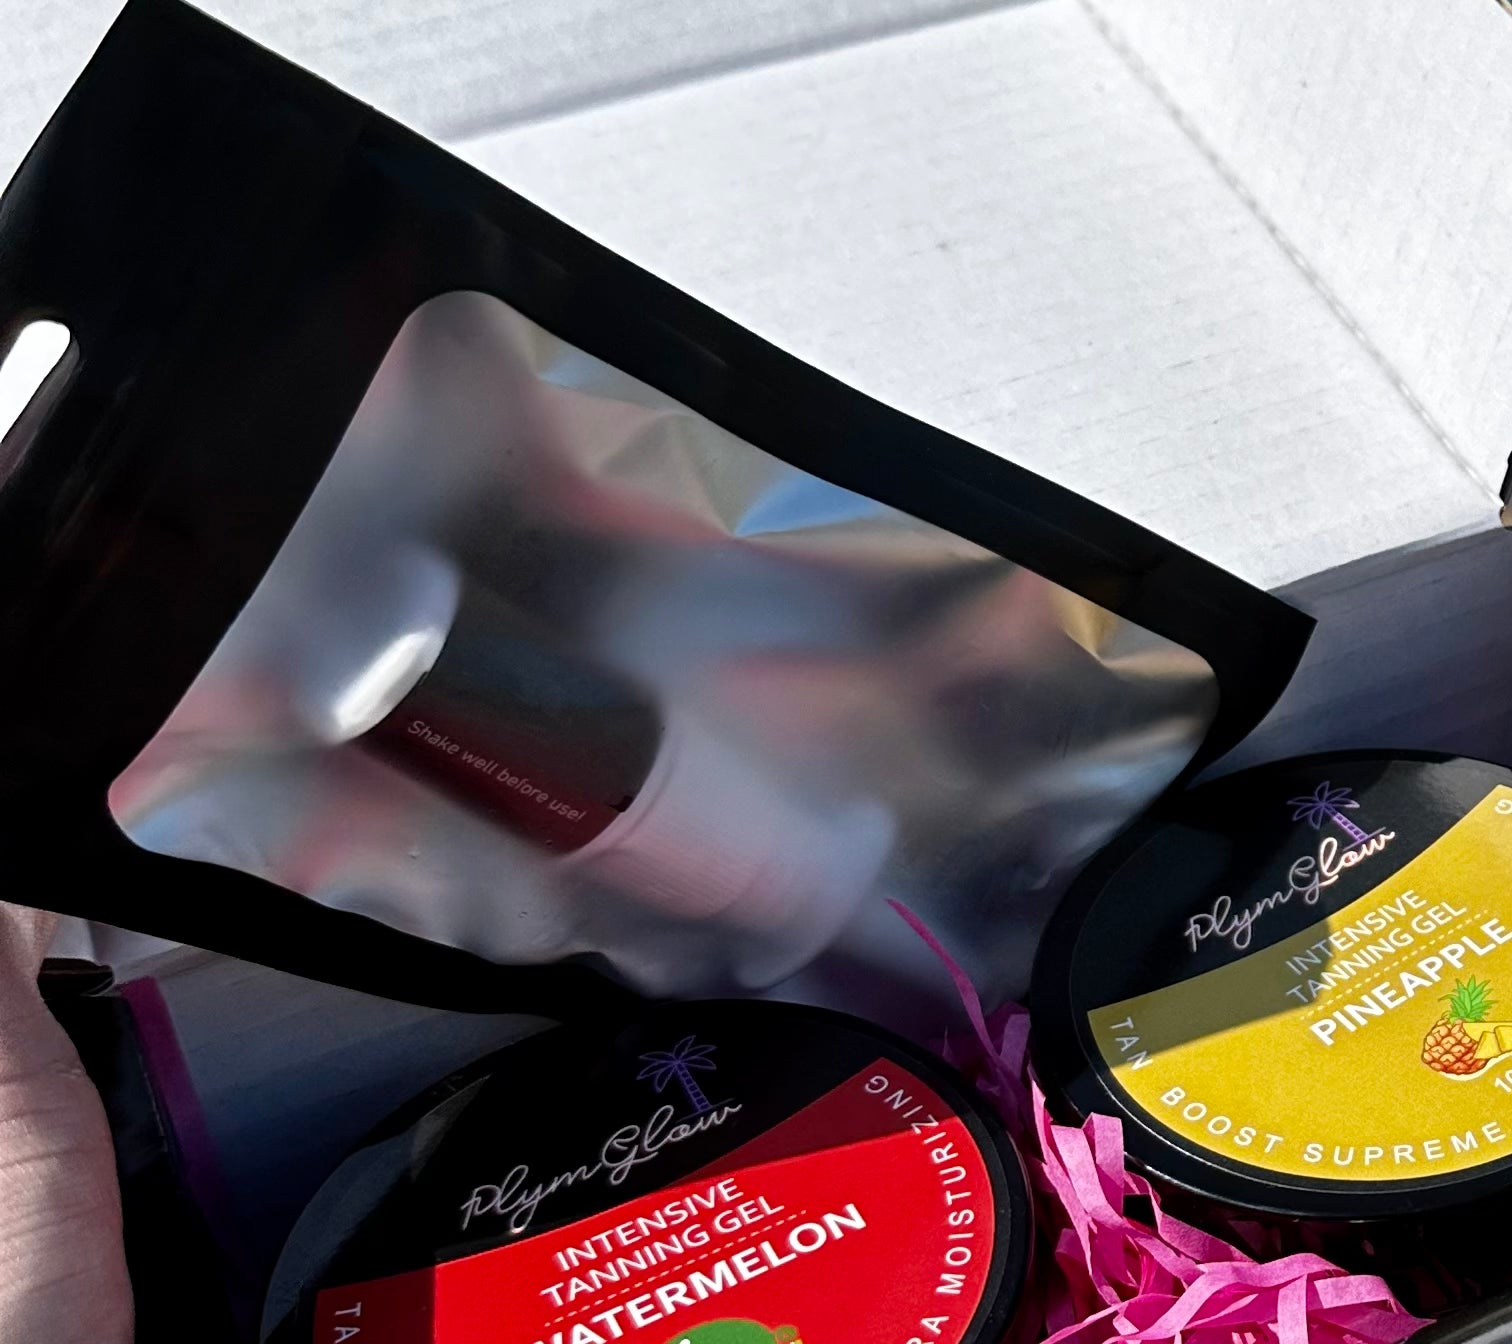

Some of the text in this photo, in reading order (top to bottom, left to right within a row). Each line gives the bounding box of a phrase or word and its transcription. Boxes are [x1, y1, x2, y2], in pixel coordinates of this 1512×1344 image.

[407, 720, 586, 822] Shake well before use!
[1285, 889, 1427, 976] INTENSIVE
[1285, 900, 1468, 1006] TANNING GEL
[1108, 1015, 1154, 1073] TAN
[1160, 1084, 1284, 1154] BOOST
[1302, 1120, 1507, 1168] SUPREME
[553, 1176, 744, 1272] INTENSIVE
[863, 1072, 976, 1297] MOISTURIZING
[540, 1194, 786, 1308] TANNING GEL
